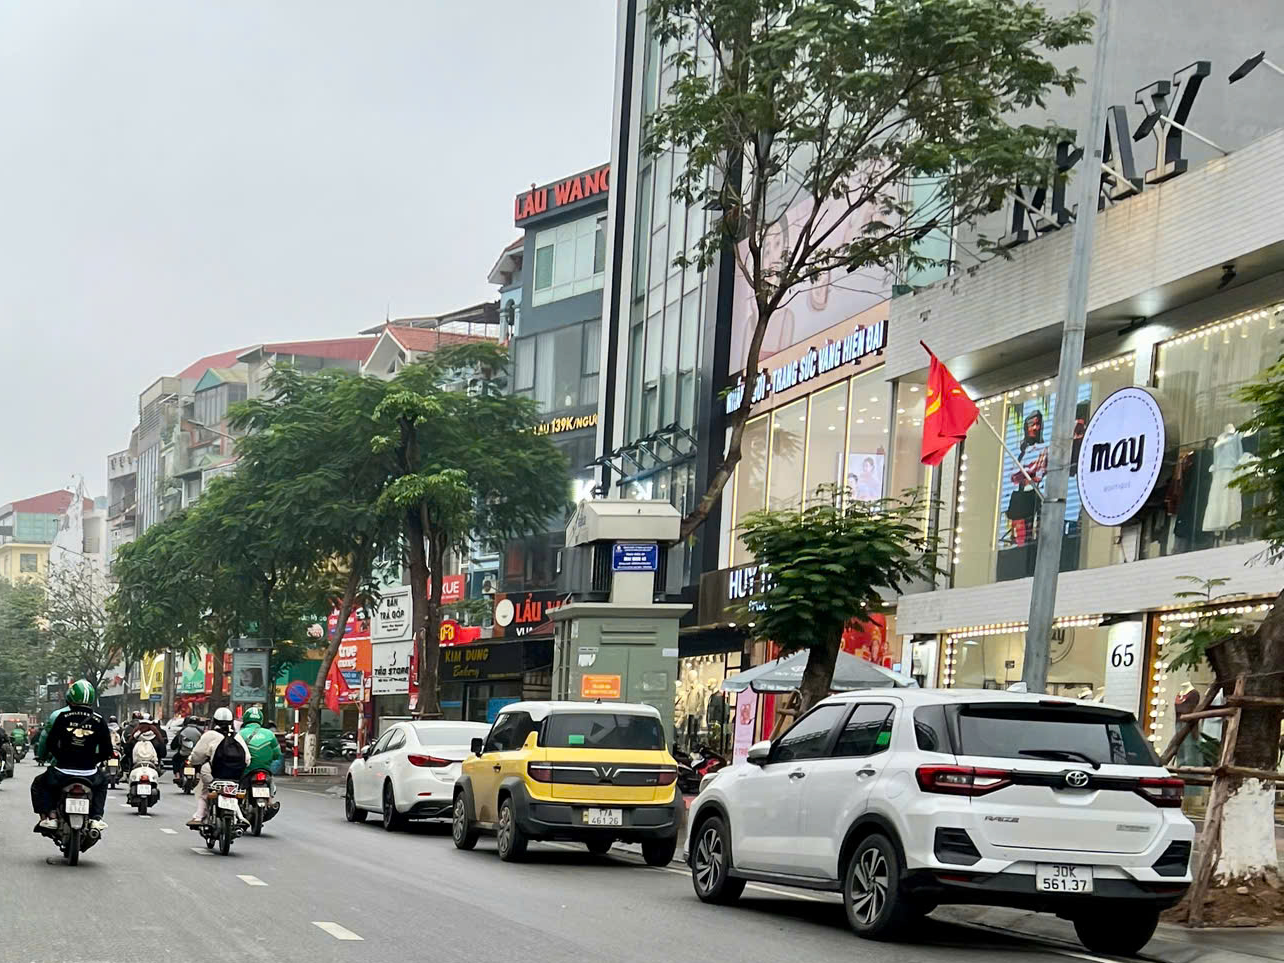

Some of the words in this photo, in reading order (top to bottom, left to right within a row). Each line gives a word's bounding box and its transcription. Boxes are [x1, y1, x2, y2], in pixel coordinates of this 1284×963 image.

[772, 360, 799, 395] TRANG
[798, 347, 818, 382] SỨC
[818, 339, 842, 374] VÀNG
[1090, 434, 1146, 473] may
[445, 650, 461, 663] KIM
[466, 648, 489, 661] DUNG
[1111, 643, 1134, 668] 65
[1052, 866, 1077, 878] 30K
[1043, 879, 1087, 892] 561.37
